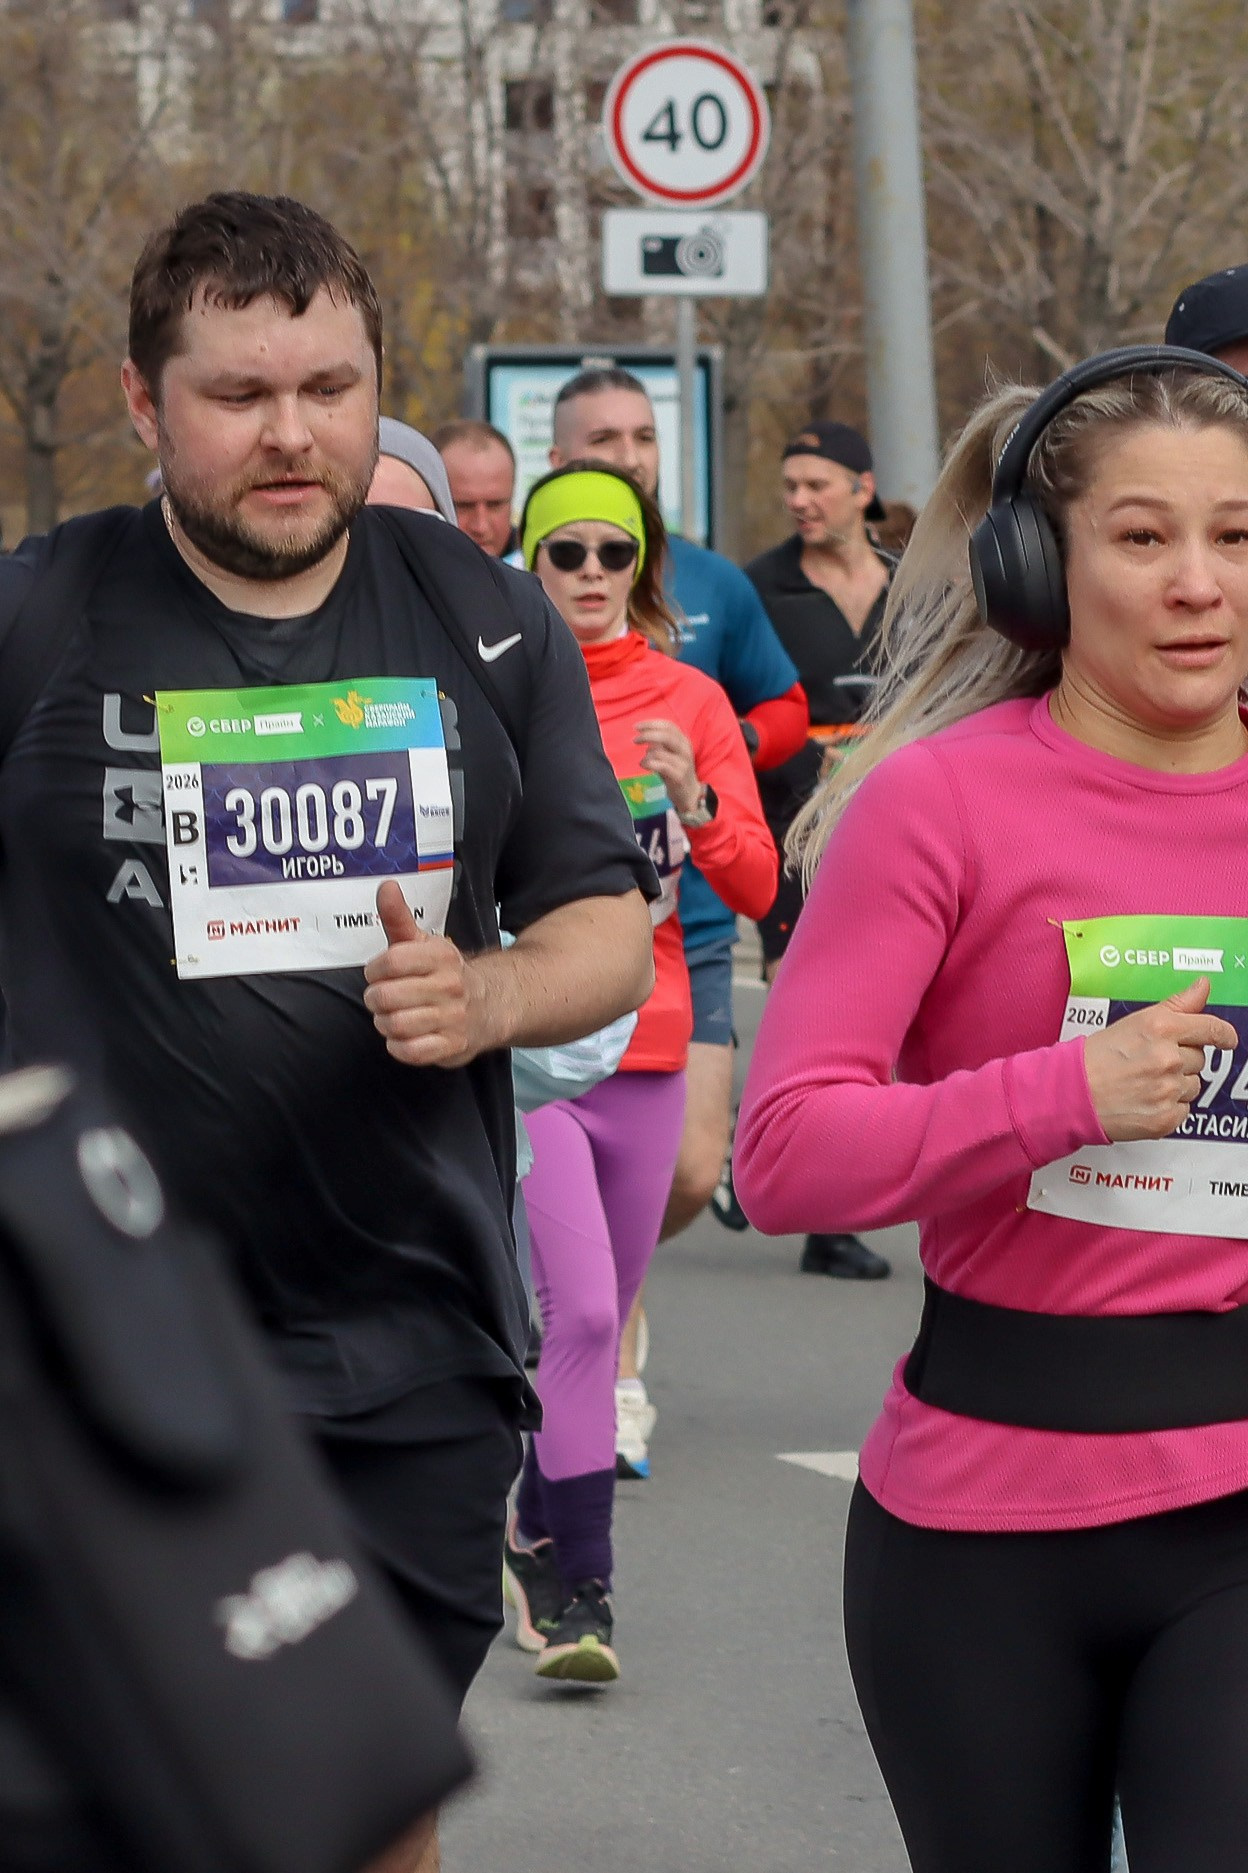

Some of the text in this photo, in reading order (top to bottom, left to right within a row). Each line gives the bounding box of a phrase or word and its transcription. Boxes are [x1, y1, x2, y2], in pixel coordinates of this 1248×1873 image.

[642, 92, 727, 151] 40
[166, 773, 200, 791] 2026
[225, 777, 399, 859] 30087
[281, 855, 345, 880] ИГОРЬ
[230, 917, 301, 936] МАГНИТ
[1124, 948, 1215, 970] СБЕР Прайм
[1067, 1007, 1104, 1026] 2026
[1095, 1172, 1174, 1192] МАГНИТ
